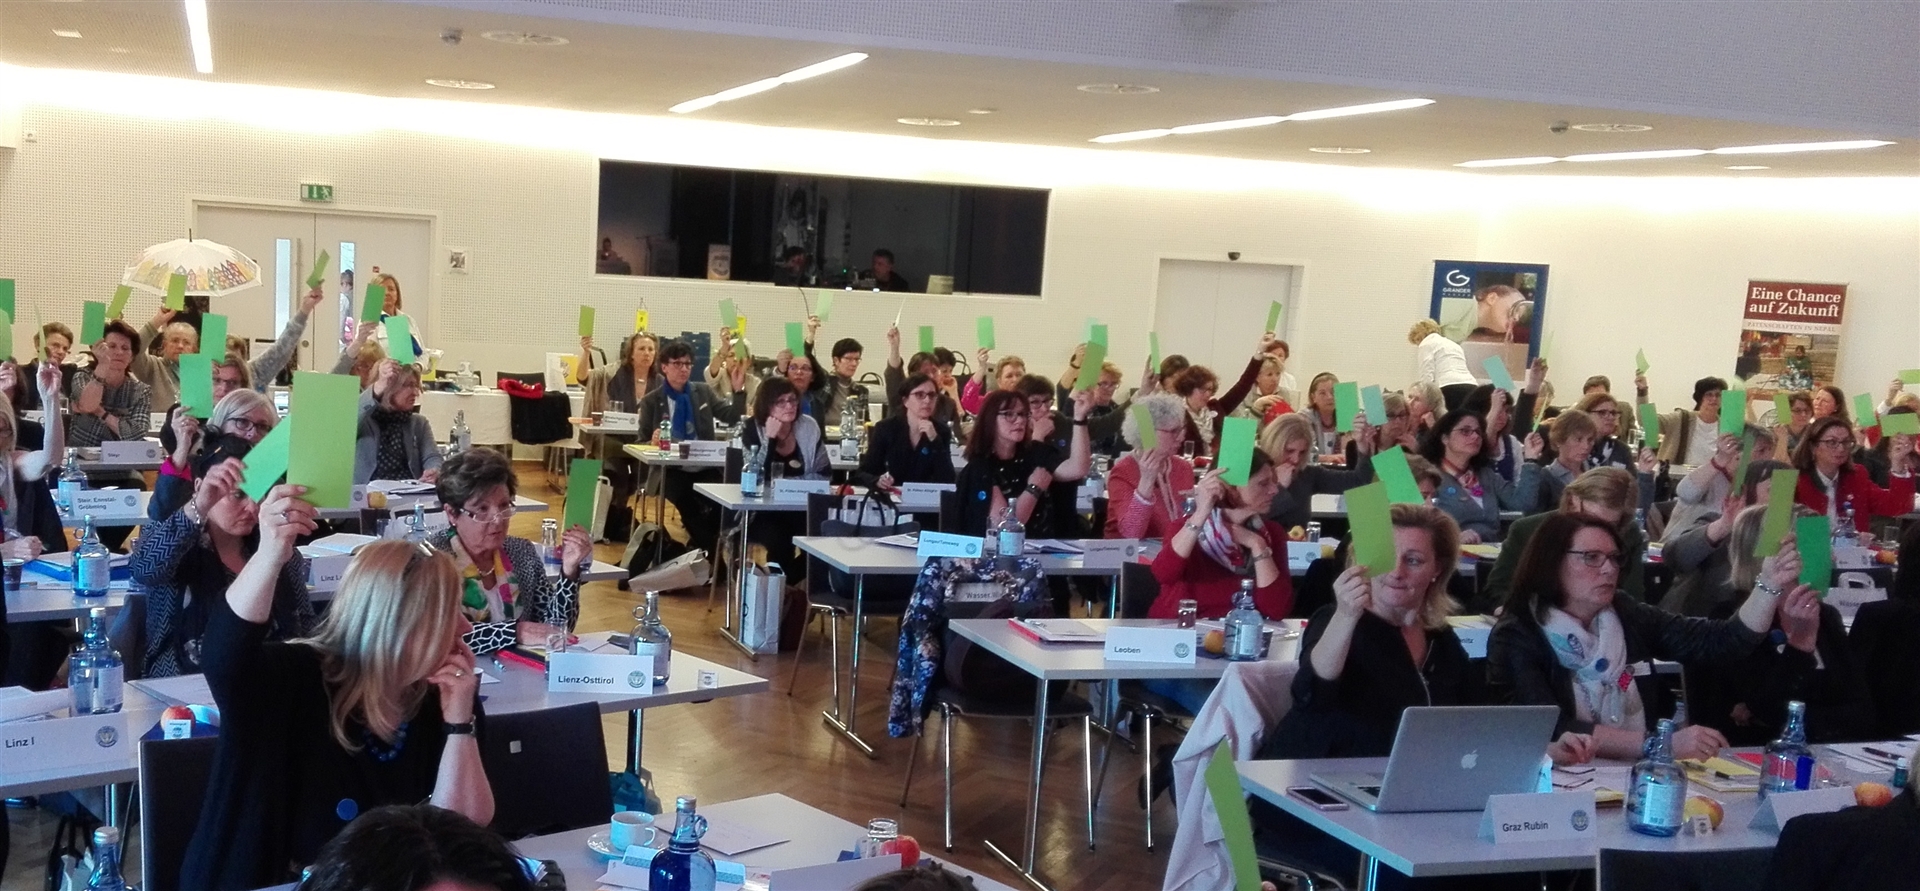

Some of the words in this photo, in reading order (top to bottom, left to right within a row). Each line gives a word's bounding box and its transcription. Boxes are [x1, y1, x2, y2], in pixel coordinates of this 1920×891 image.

[1751, 287, 1783, 300] Eine
[1787, 289, 1841, 303] Chance
[1749, 302, 1776, 314] auf
[1777, 302, 1839, 317] Zukunft
[1747, 321, 1802, 331] PATENSCHAFTEN
[1114, 646, 1141, 654] Leoben
[558, 675, 614, 685] Lienz-Osttirol
[5, 738, 29, 748] Linz
[1502, 823, 1522, 832] Graz
[1523, 822, 1549, 831] Rubin
